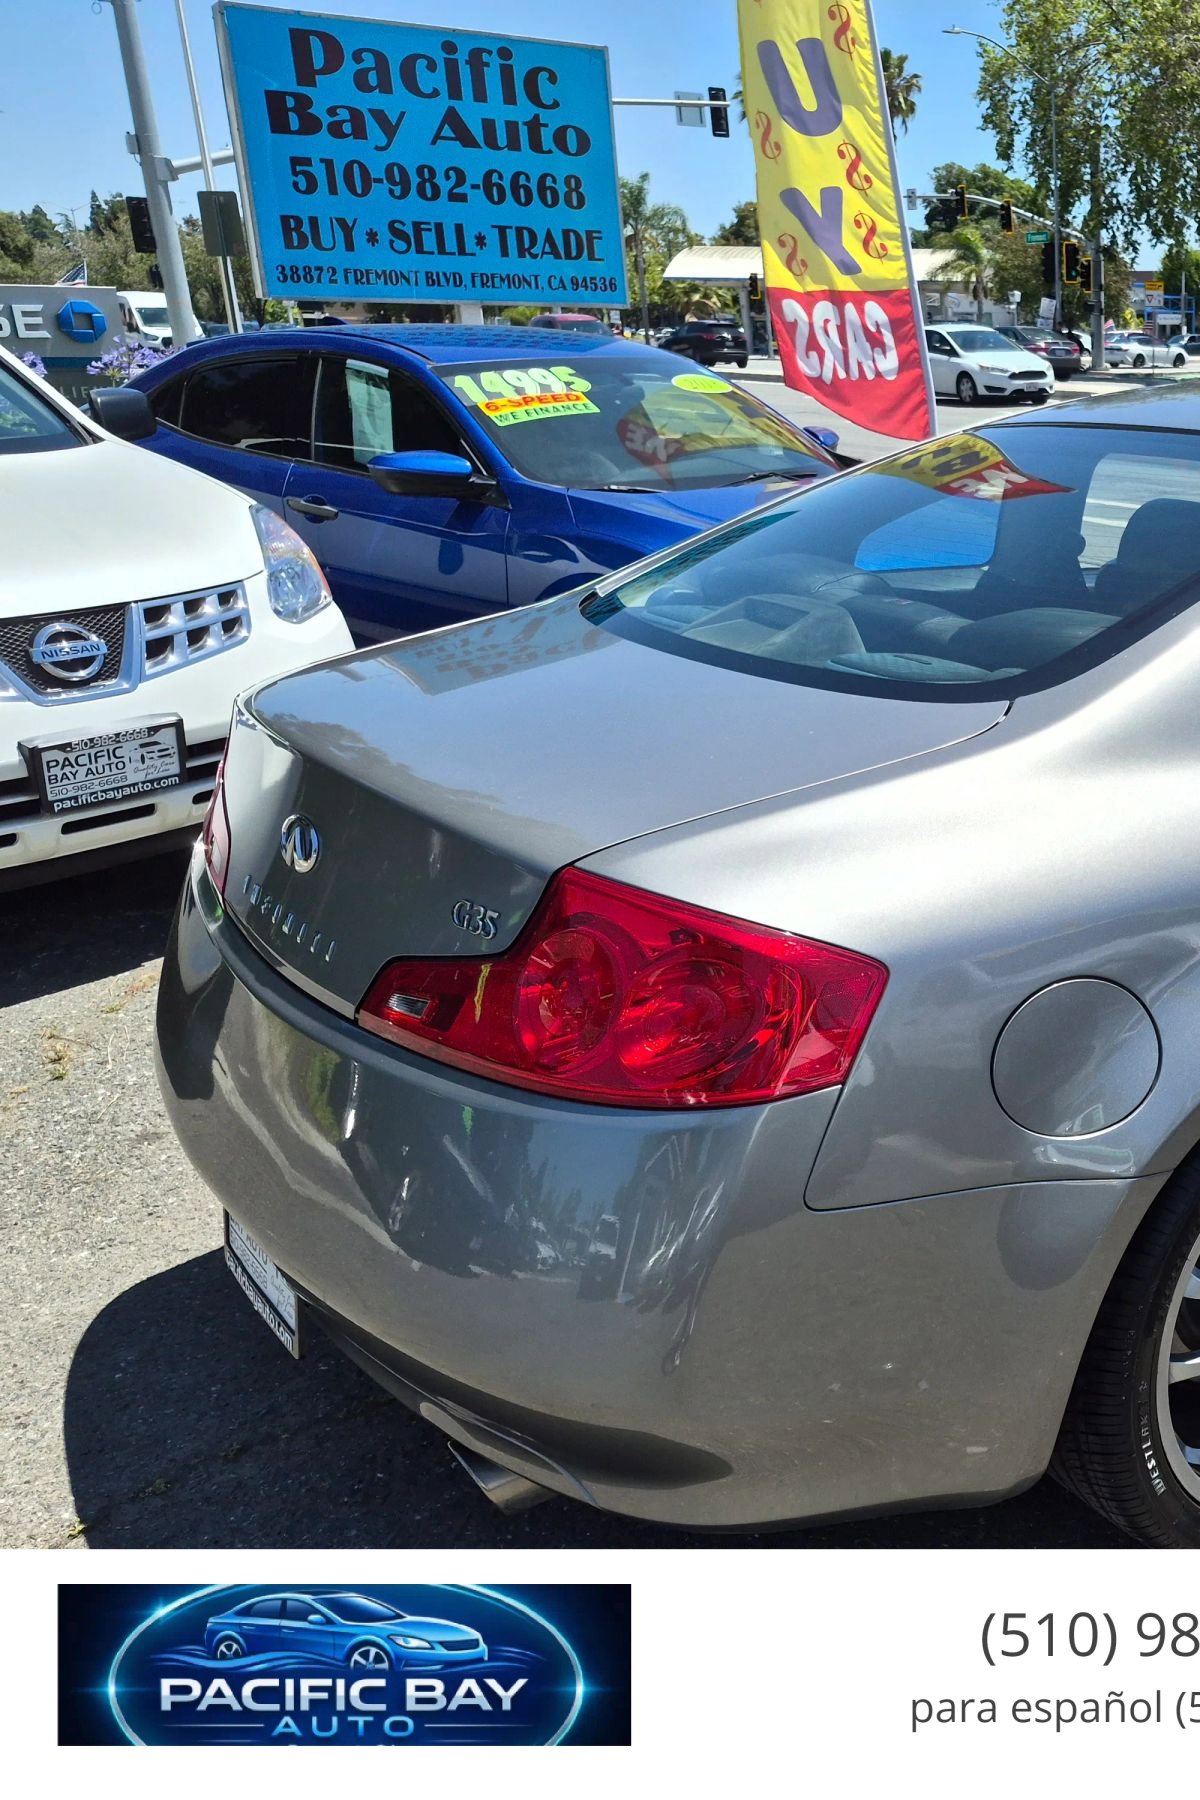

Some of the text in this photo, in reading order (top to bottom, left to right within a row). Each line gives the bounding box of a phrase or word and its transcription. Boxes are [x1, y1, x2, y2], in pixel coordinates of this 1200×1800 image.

[288, 27, 560, 110] Pacific
[264, 89, 591, 157] Bay Auto
[289, 156, 586, 210] 510-982-6668
[280, 214, 605, 261] BUY SELL TRADE
[275, 264, 618, 293] 38872 FREMONT BLVD, FREMONT, CA 94536
[454, 366, 592, 404] 14995
[485, 393, 580, 411] 6-SPEED
[494, 403, 594, 423] WE FINANCE
[40, 642, 101, 659] NISSAN
[71, 728, 149, 752] 510-982-6668
[45, 745, 125, 774] PACIFIC
[48, 761, 126, 786] BAY AUTO
[50, 774, 128, 799] 510-982-6668
[53, 775, 180, 813] pacificbayauto.com
[451, 900, 501, 940] G35
